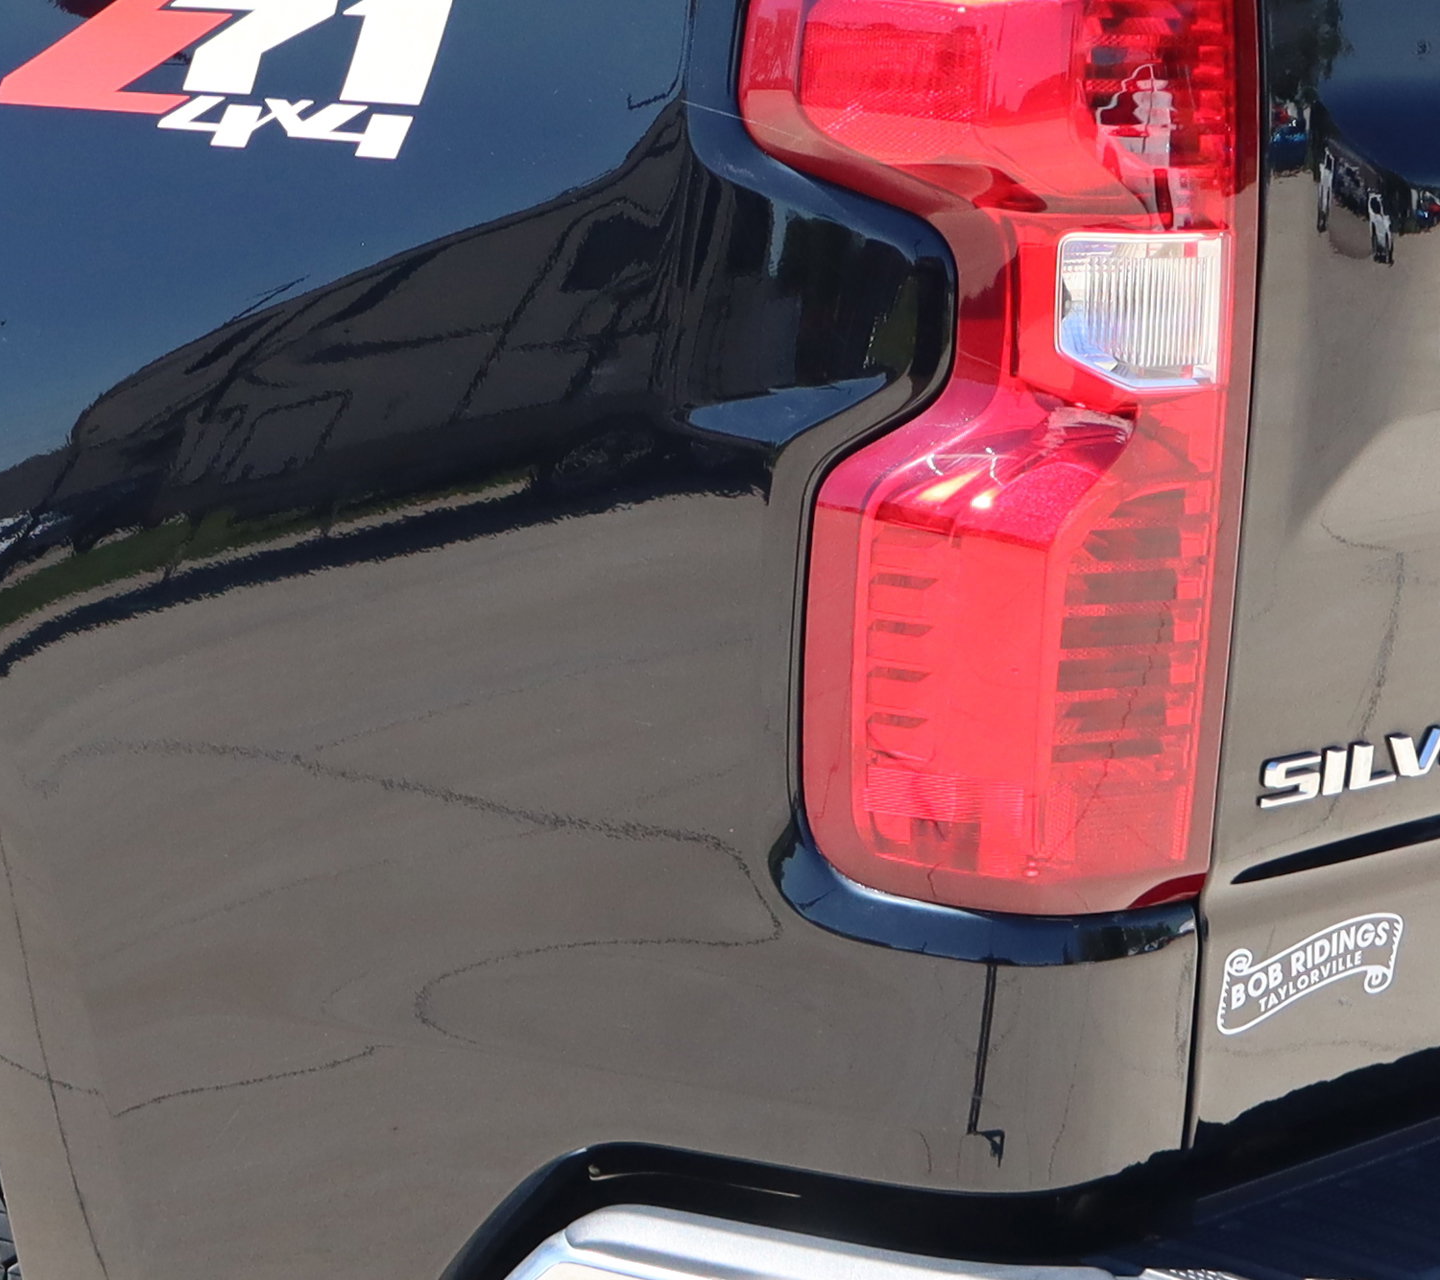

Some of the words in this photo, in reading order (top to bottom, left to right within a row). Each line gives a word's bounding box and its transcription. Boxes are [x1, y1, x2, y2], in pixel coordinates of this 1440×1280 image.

[1230, 961, 1283, 1011] BOB
[1290, 920, 1390, 978] RIDINGS
[1258, 950, 1363, 1013] TAYLORVILLE
